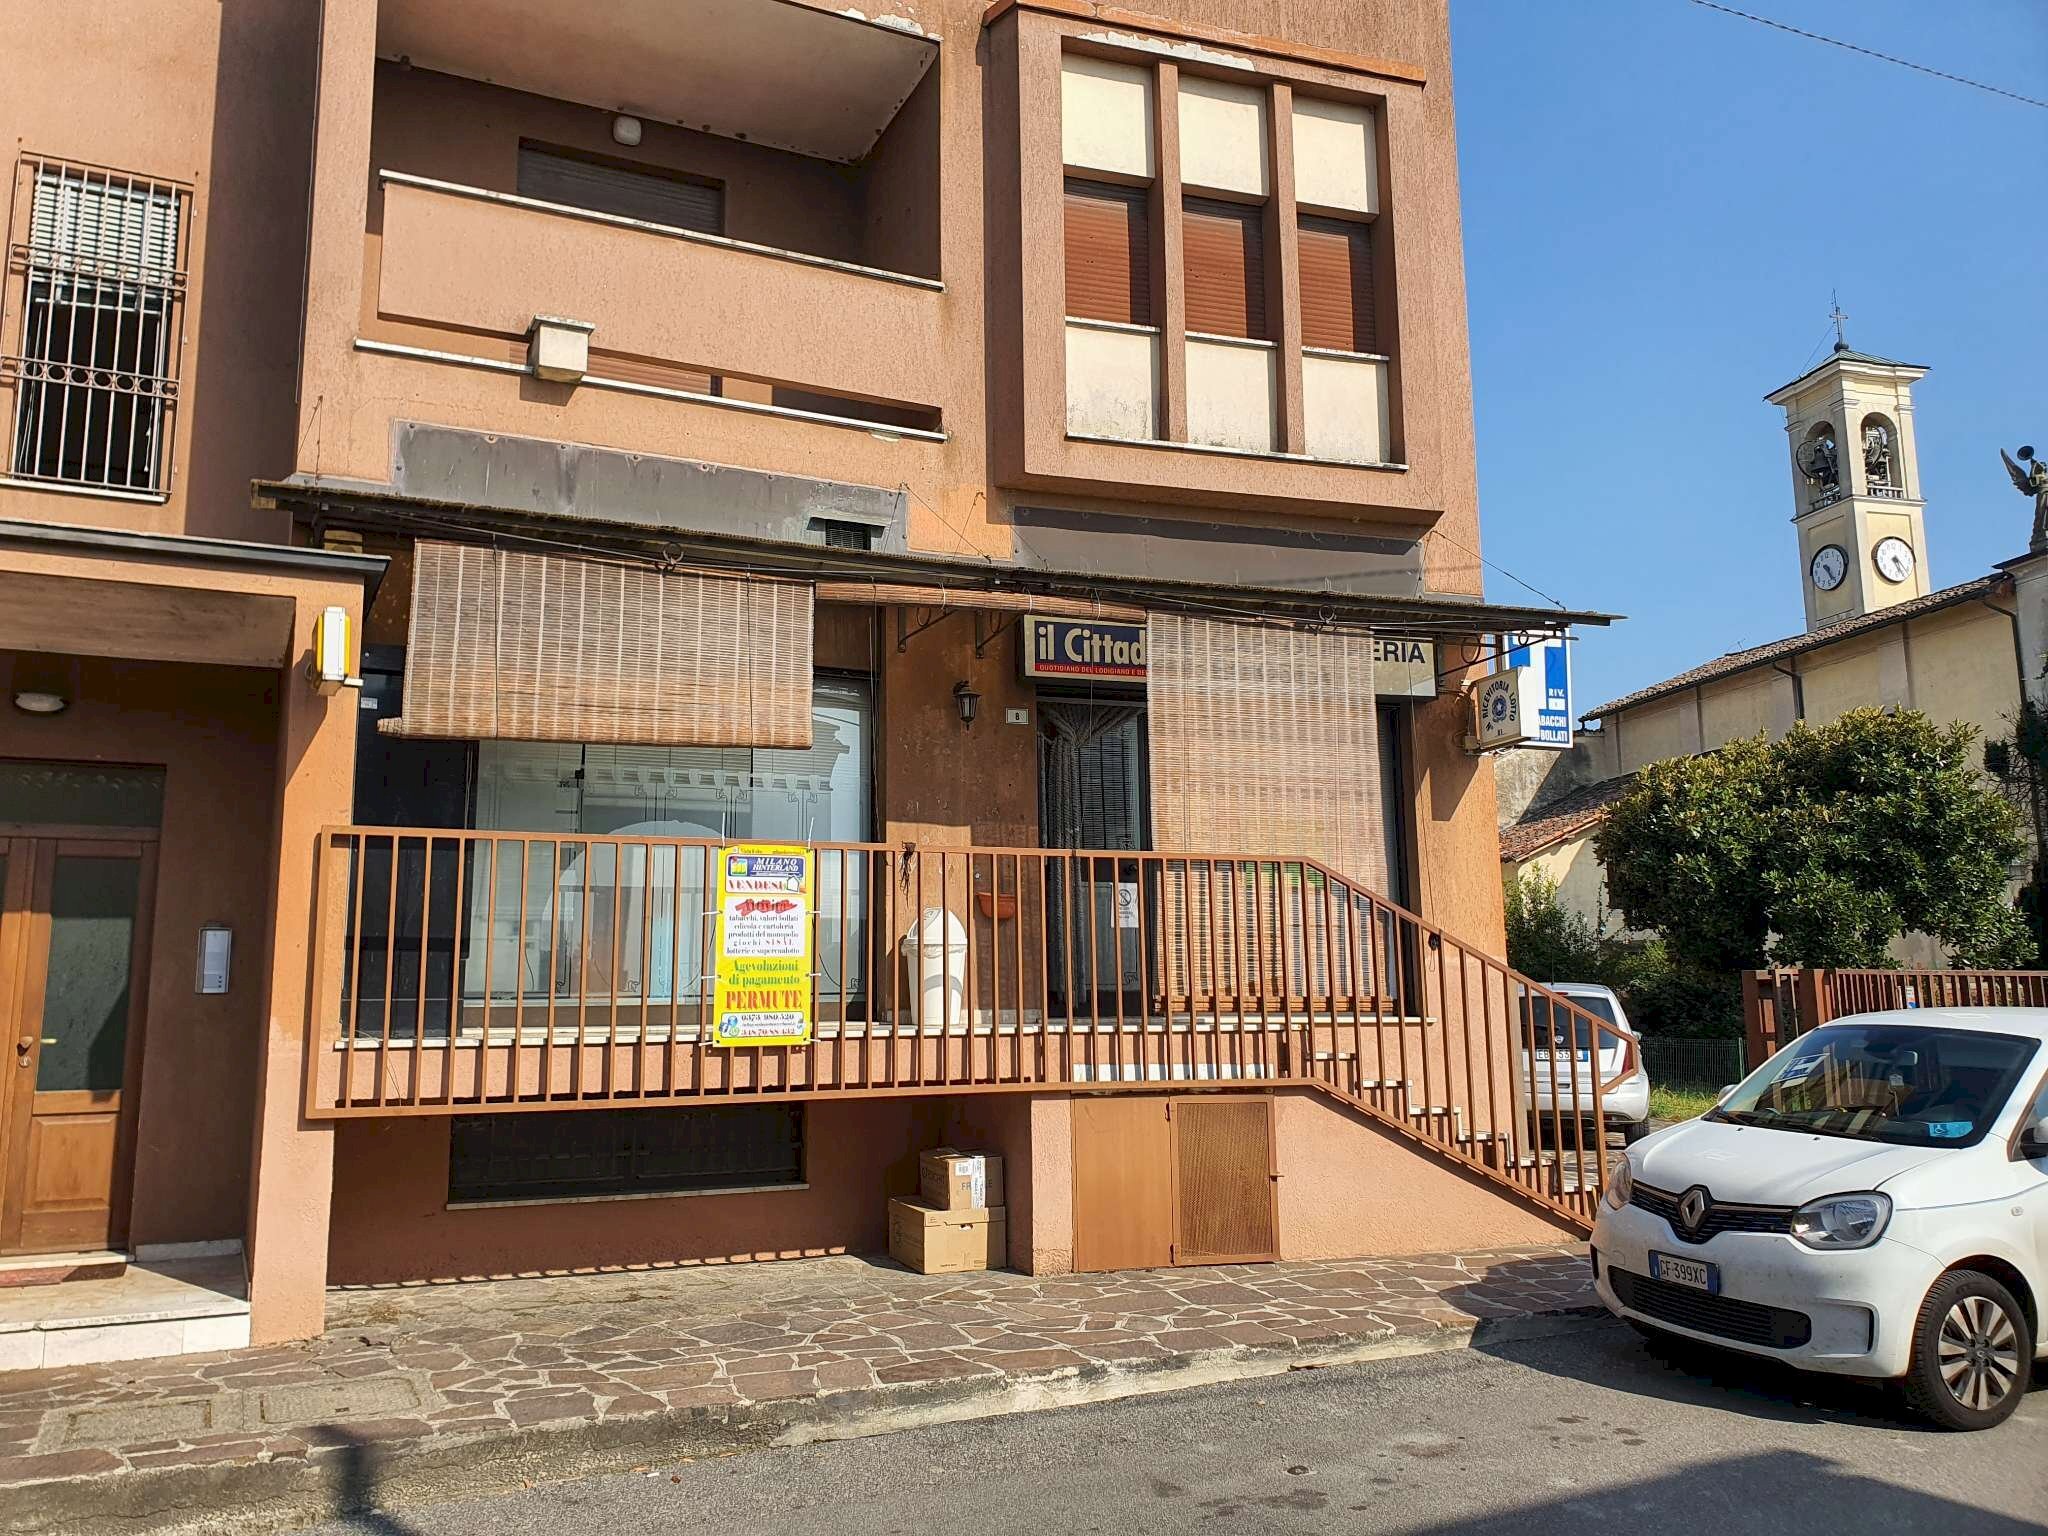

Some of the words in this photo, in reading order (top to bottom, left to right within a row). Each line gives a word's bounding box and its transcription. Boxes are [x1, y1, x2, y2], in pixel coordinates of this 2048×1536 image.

[1038, 624, 1054, 660] il
[1064, 627, 1146, 666] Cittad
[1095, 666, 1130, 675] LODIGIANO
[1509, 691, 1517, 721] LOTTO
[1540, 715, 1567, 728] BACCHI
[1541, 730, 1568, 742] BOLLATI
[728, 880, 782, 890] VENDESI
[734, 960, 798, 973] Agevolazioni
[729, 973, 739, 985] di
[743, 974, 800, 988] pagamento
[725, 990, 802, 1010] PERMUTE
